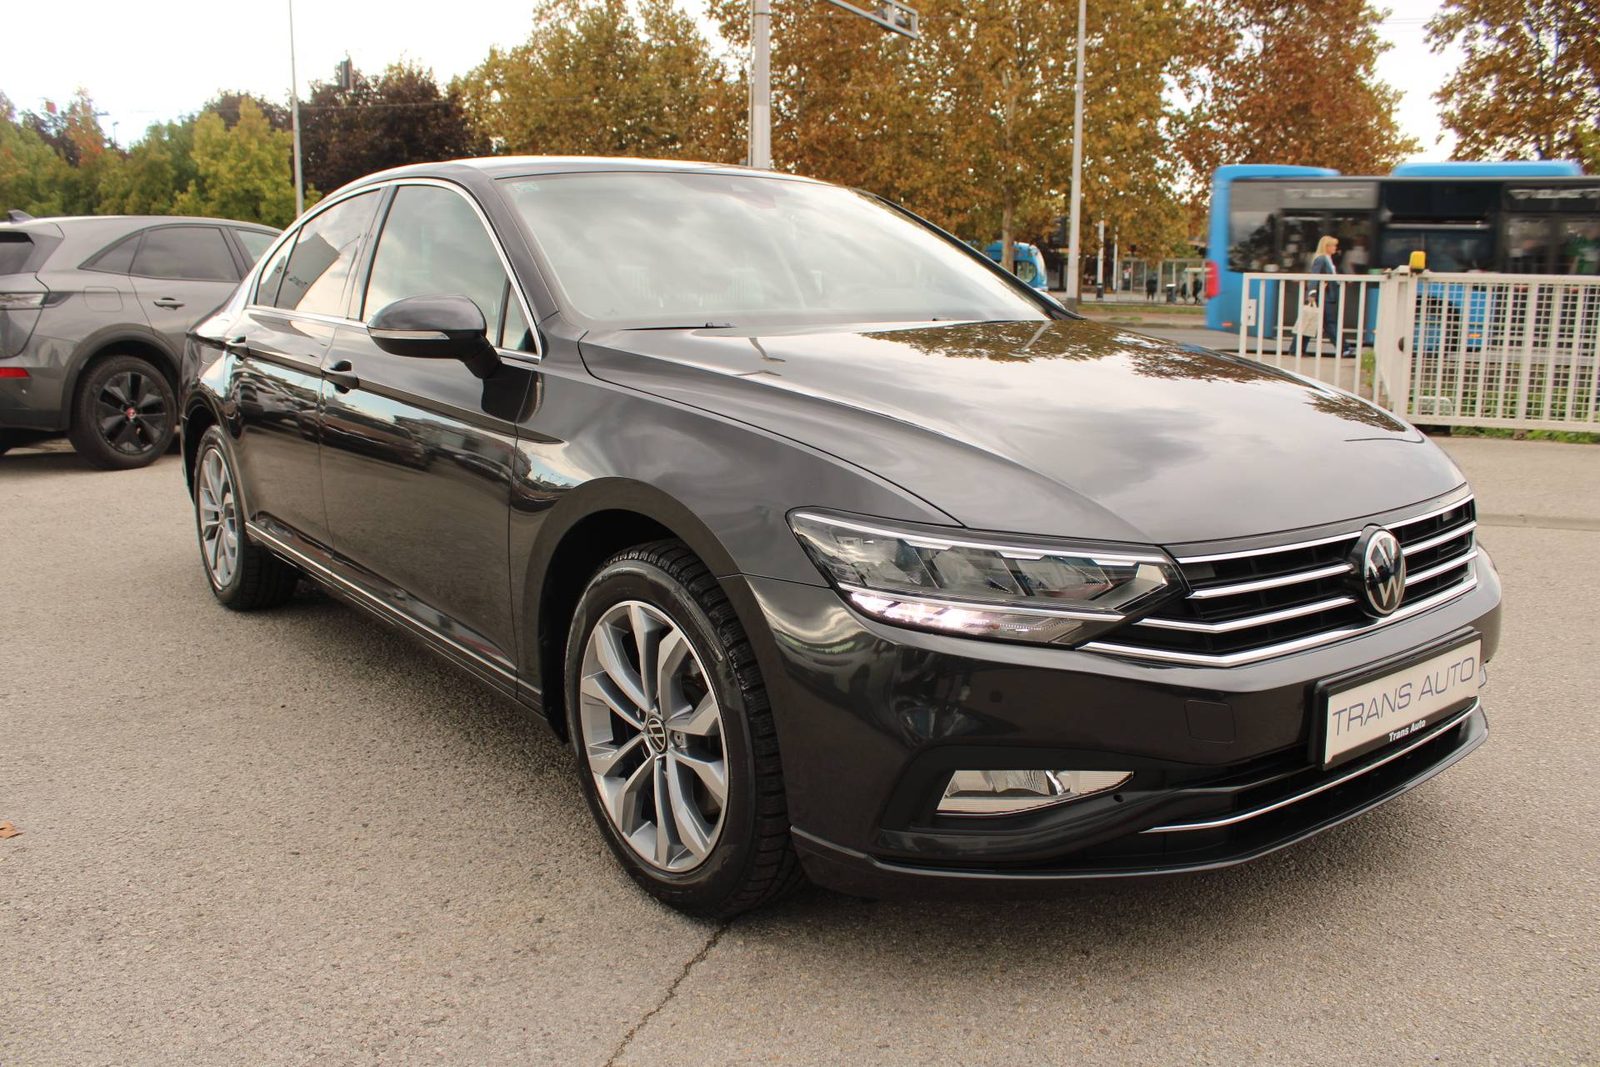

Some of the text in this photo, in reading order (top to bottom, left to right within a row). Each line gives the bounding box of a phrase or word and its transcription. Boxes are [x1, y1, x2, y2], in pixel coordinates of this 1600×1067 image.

[1332, 656, 1475, 736] TRANS AUTO
[1388, 719, 1426, 742] Trans Auto
